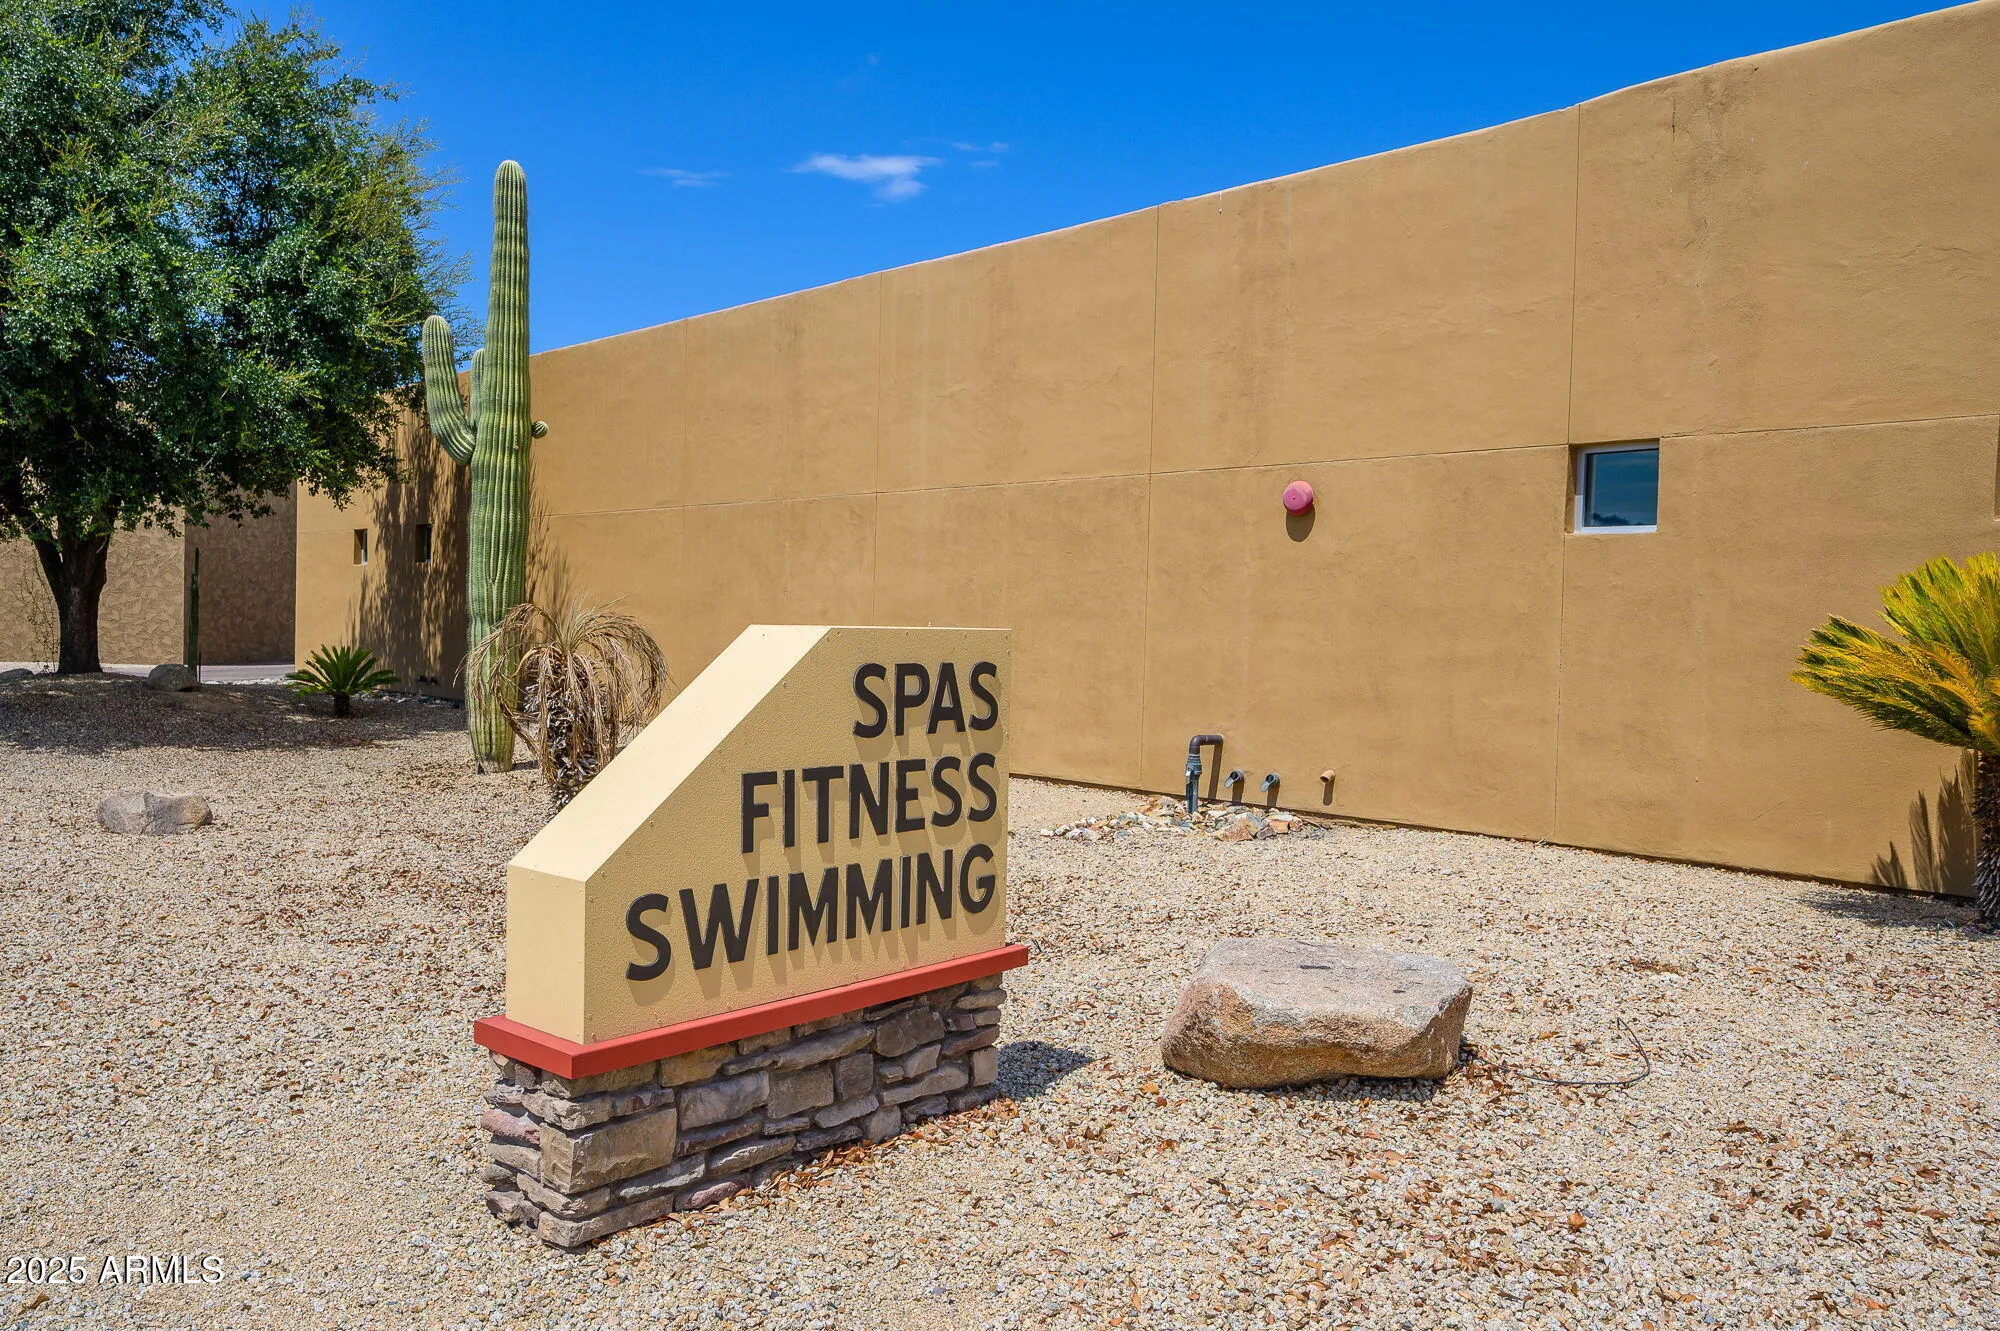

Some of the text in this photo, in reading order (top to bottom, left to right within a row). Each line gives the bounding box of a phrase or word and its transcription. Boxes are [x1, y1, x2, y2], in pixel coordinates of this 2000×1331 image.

[852, 661, 998, 738] SPAS
[741, 752, 997, 854] FITNESS
[624, 843, 996, 981] SWIMMING
